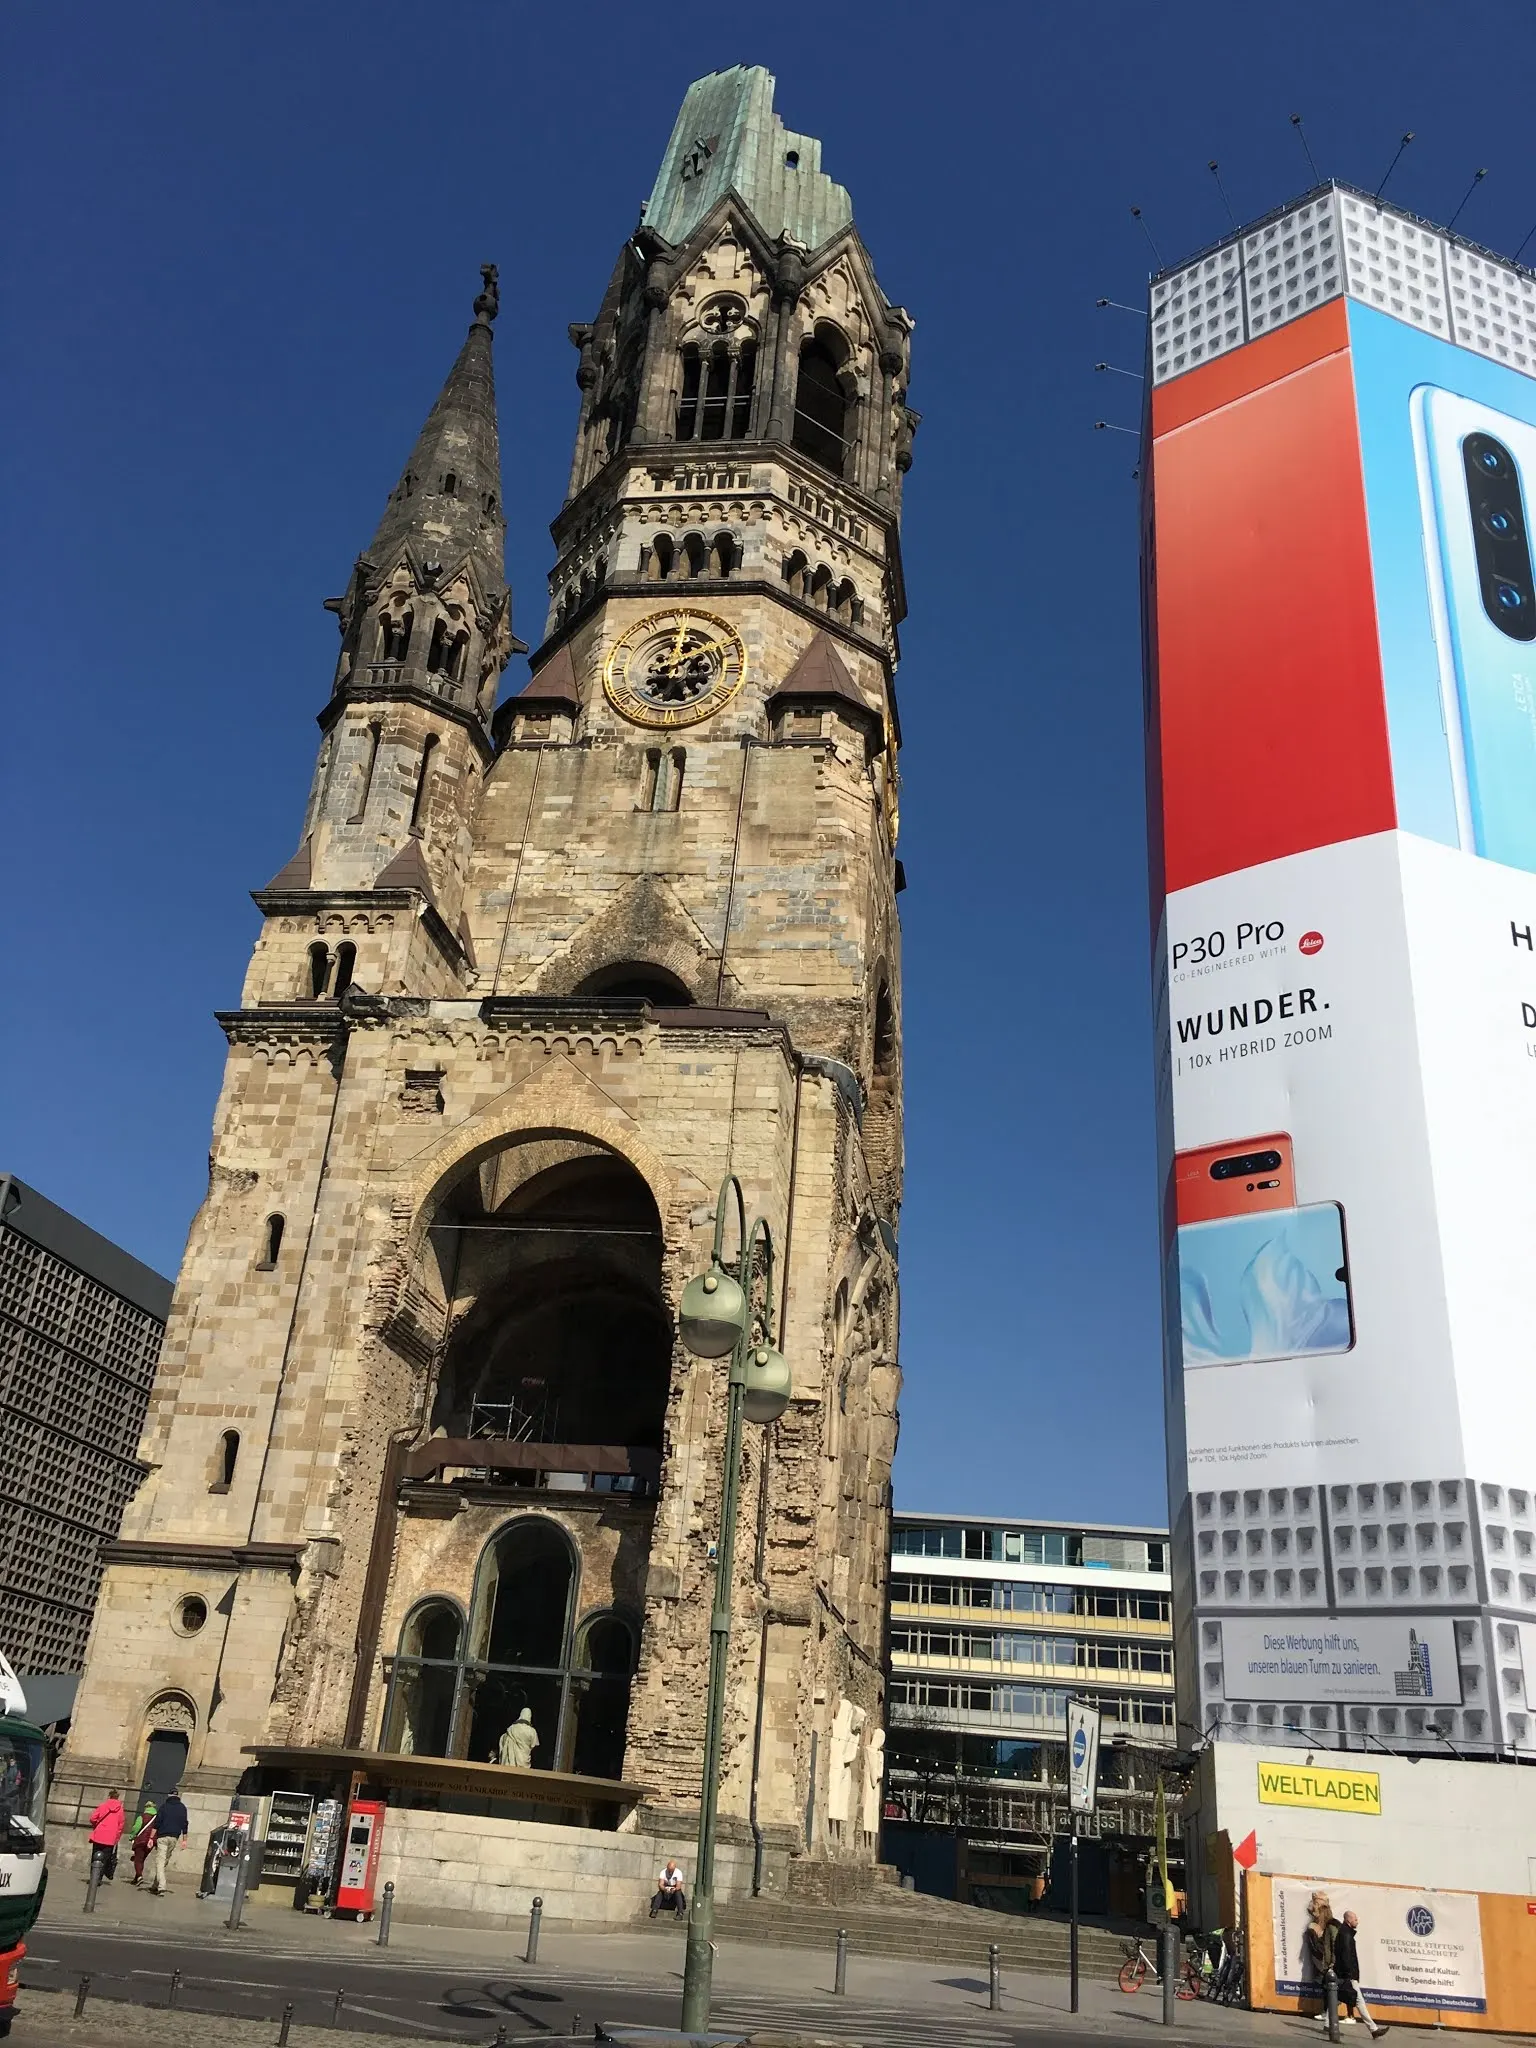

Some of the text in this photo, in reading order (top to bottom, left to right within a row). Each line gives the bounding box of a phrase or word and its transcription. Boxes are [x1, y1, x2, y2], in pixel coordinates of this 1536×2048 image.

[1173, 921, 1284, 970] P30 Pro
[1173, 945, 1286, 983] CO-ENGINEERED WITH
[1177, 987, 1330, 1043] WUNDER.
[1219, 1037, 1276, 1062] HYBRID
[1284, 1024, 1332, 1047] ZOOM
[1264, 1633, 1360, 1654] Diese Werbung hilft uns,
[1248, 1658, 1381, 1676] unseren blauen Turm zu sanieren.
[1261, 1773, 1379, 1803] WELTLADEN
[1279, 1890, 1288, 1976] www.denkmalschutz.de
[1380, 1938, 1465, 1951] DEUTSCHE STIFTUNG
[1387, 1946, 1459, 1958] DENKMALSCHUTZ
[1395, 1975, 1409, 1983] Ihre
[1410, 1977, 1436, 1985] Spende
[1401, 1964, 1424, 1973] bauen
[1424, 1966, 1436, 1974] auf
[1437, 1967, 1461, 1976] Kultur.
